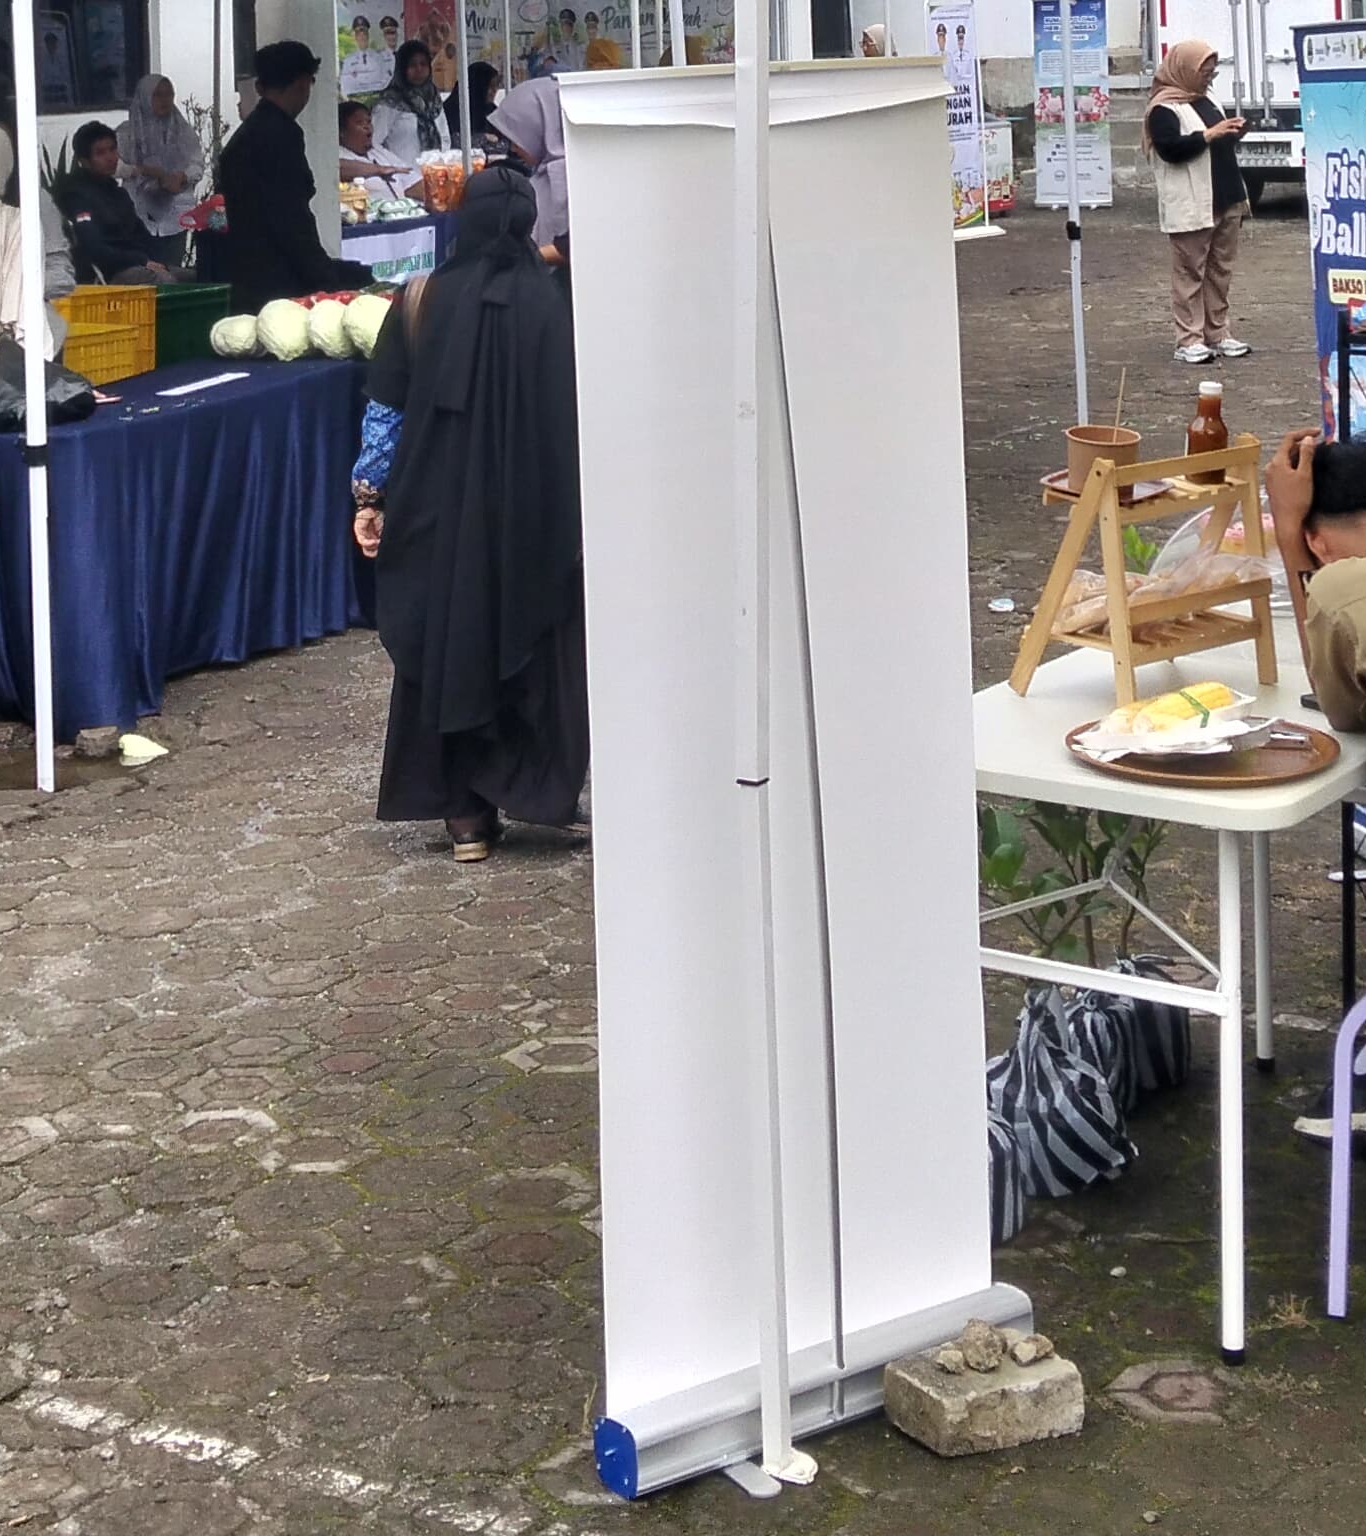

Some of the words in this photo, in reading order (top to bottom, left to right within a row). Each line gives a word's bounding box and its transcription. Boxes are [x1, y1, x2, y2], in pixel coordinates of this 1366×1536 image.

[602, 6, 654, 31] Panan
[946, 96, 972, 110] NGAN
[947, 111, 973, 127] URAH
[1332, 277, 1363, 295] BAKSO
